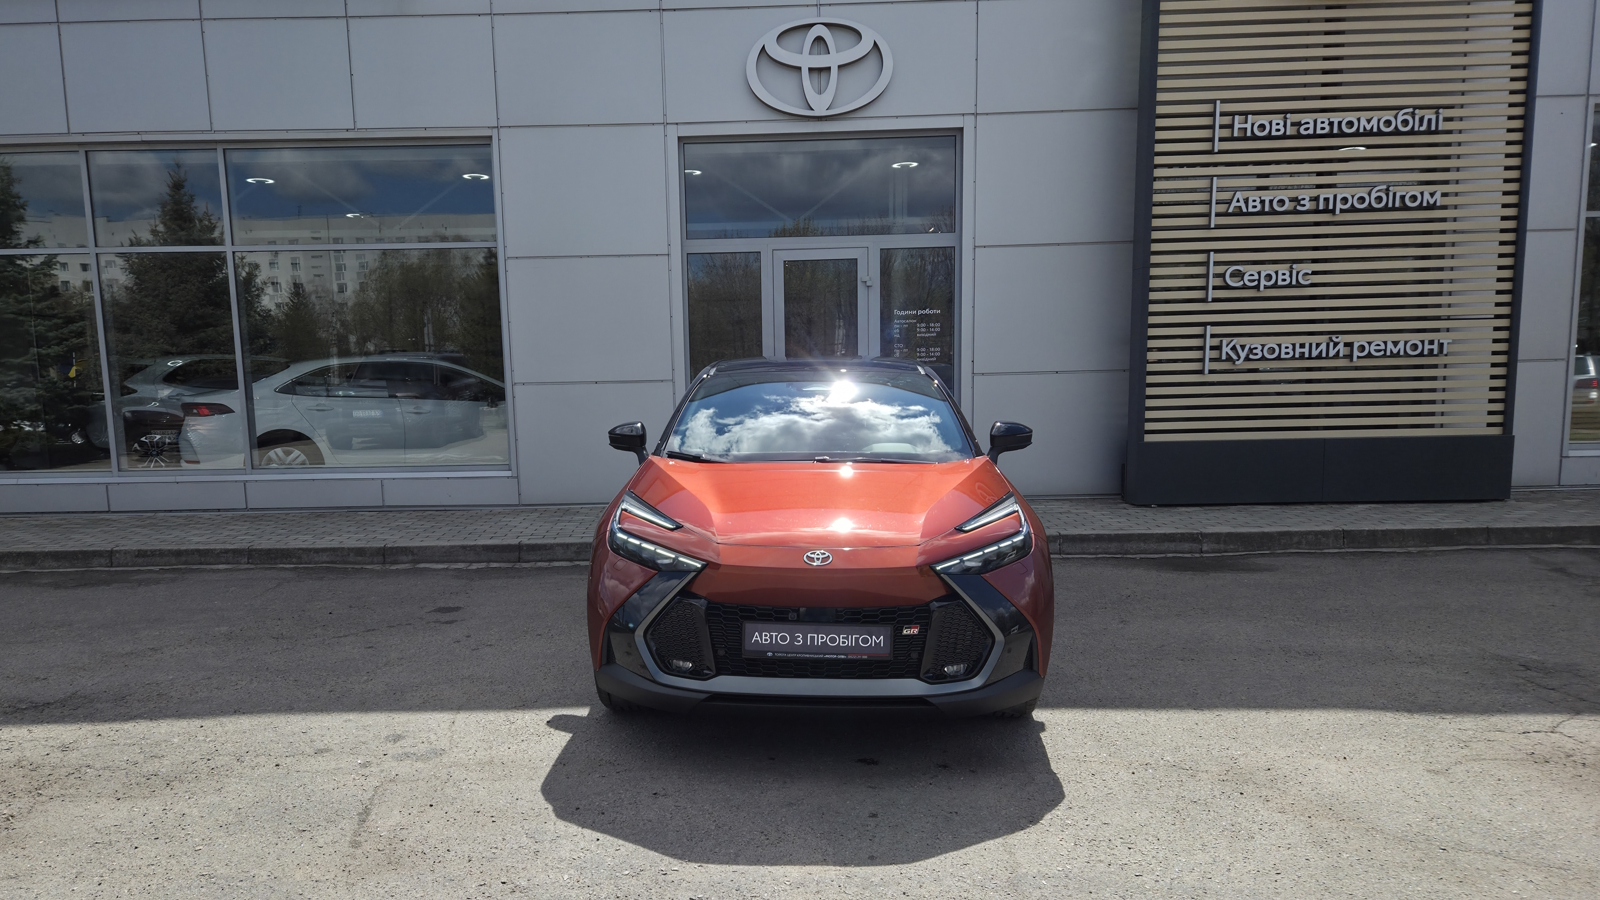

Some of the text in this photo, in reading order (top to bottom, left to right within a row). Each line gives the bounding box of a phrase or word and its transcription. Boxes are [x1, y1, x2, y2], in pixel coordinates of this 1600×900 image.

[1232, 108, 1444, 137] Нові автомобілі
[1227, 185, 1442, 215] Авто з пробігом
[1223, 264, 1313, 291] Сервіс
[917, 308, 941, 316] роботи
[1220, 336, 1452, 364] Кузовний ремонт
[751, 631, 884, 647] АВТО З ПРОБІГОМ
